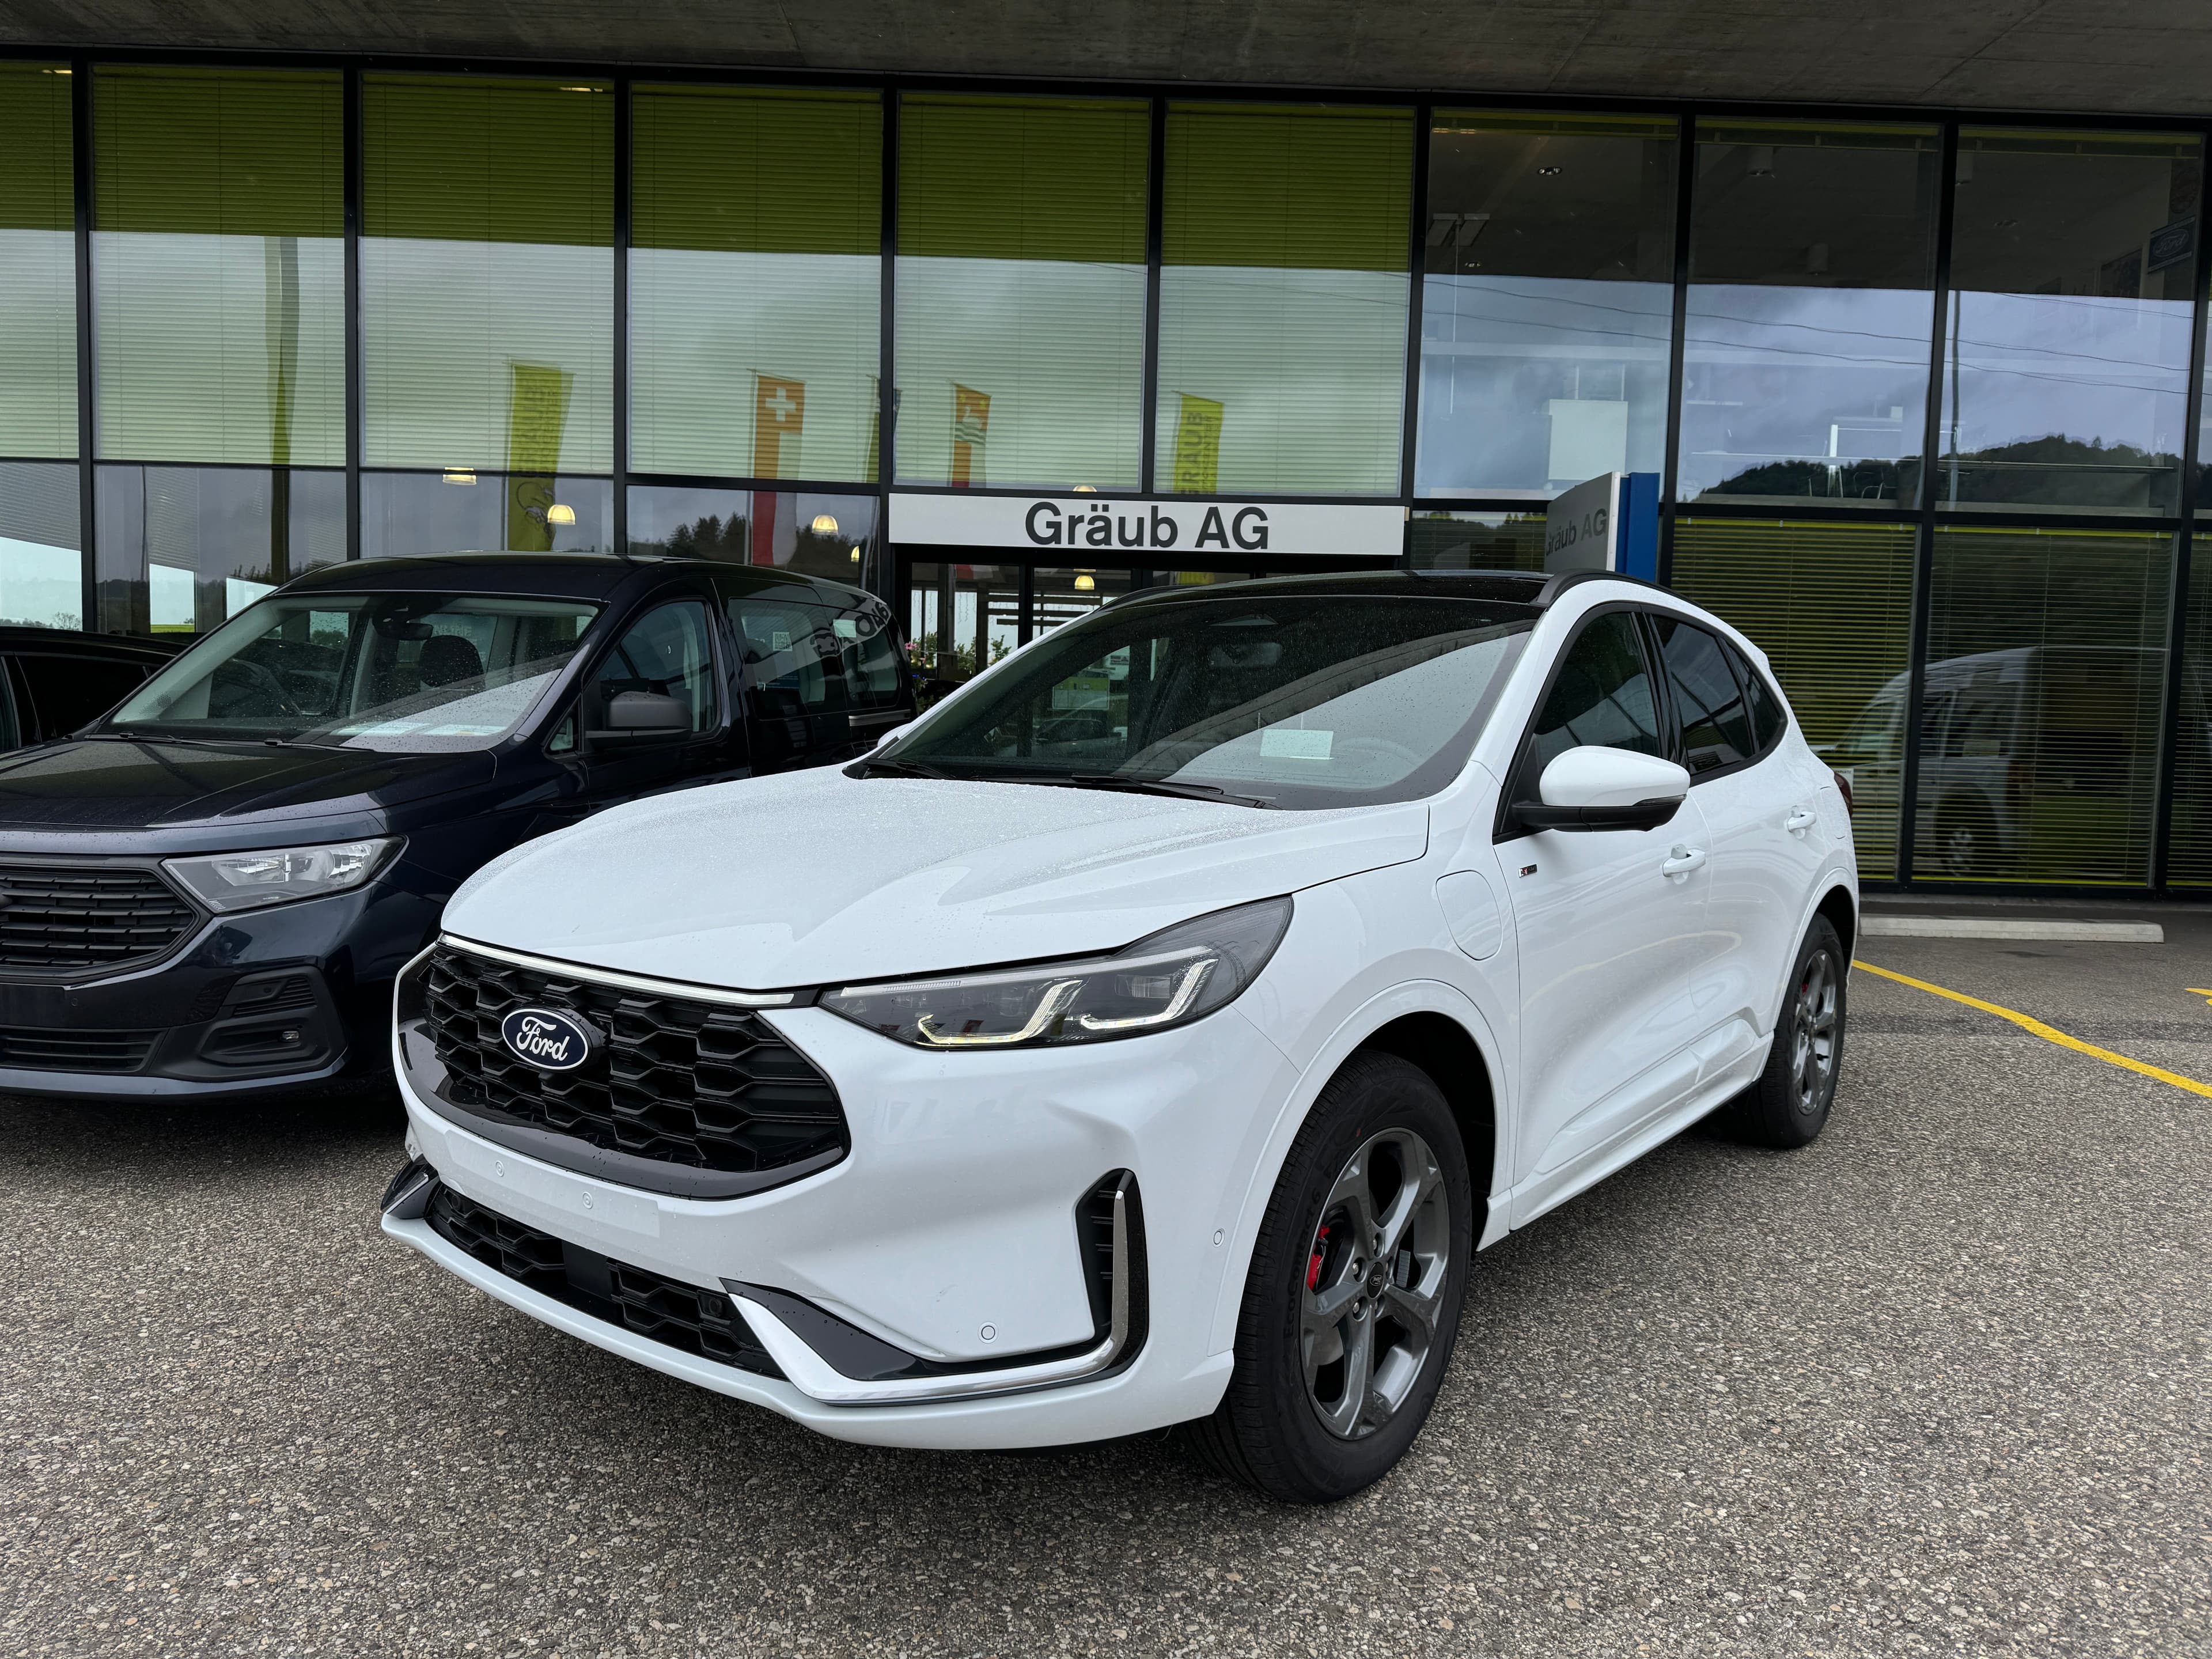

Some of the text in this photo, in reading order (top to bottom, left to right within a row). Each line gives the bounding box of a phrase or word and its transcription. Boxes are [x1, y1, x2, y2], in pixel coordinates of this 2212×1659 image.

[1025, 501, 1269, 550] Gräub AG
[1581, 508, 1607, 541] AG
[516, 1016, 570, 1061] Ford
[1283, 1207, 1315, 1339] EcoContact
